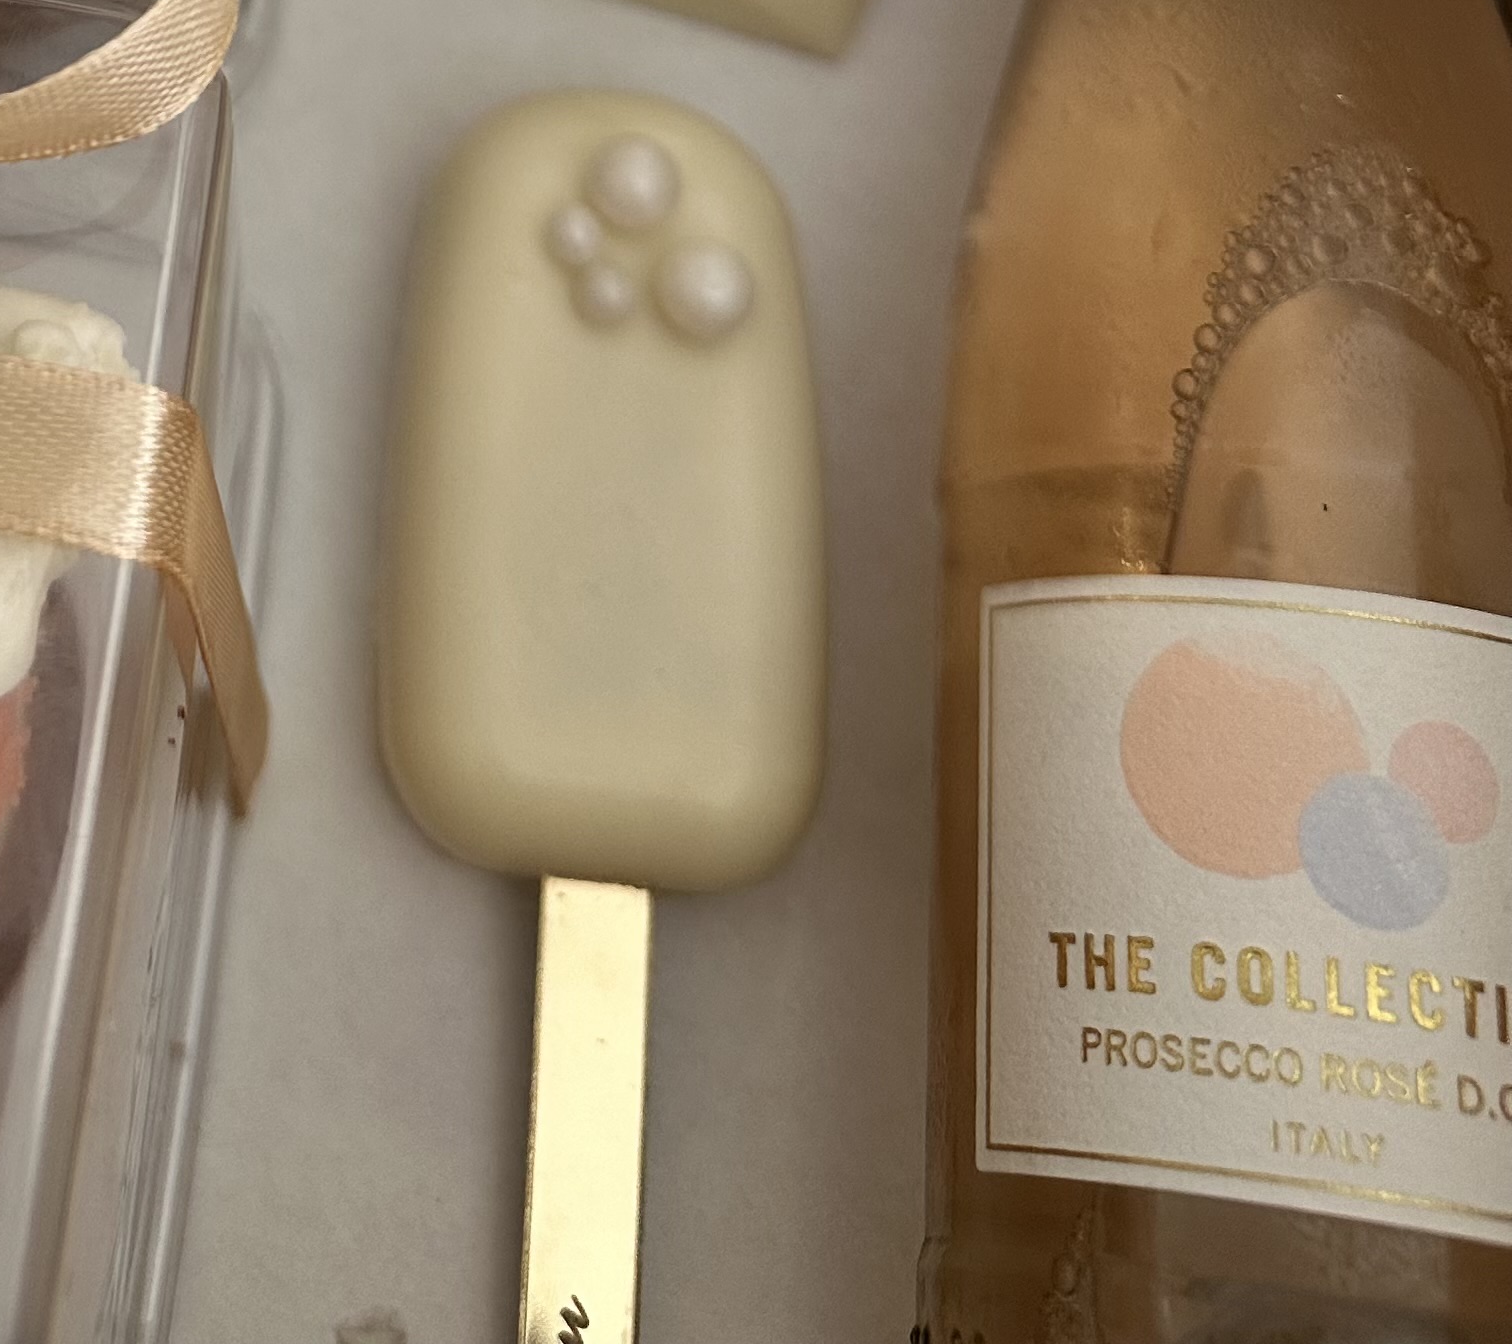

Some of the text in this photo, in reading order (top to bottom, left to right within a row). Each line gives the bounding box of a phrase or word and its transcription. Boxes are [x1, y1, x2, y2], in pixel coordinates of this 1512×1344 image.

[1049, 930, 1157, 995] THE
[1081, 1025, 1304, 1088] PROSECCO
[1320, 1052, 1441, 1110] ROSÉ
[1269, 1118, 1386, 1169] ITALY
